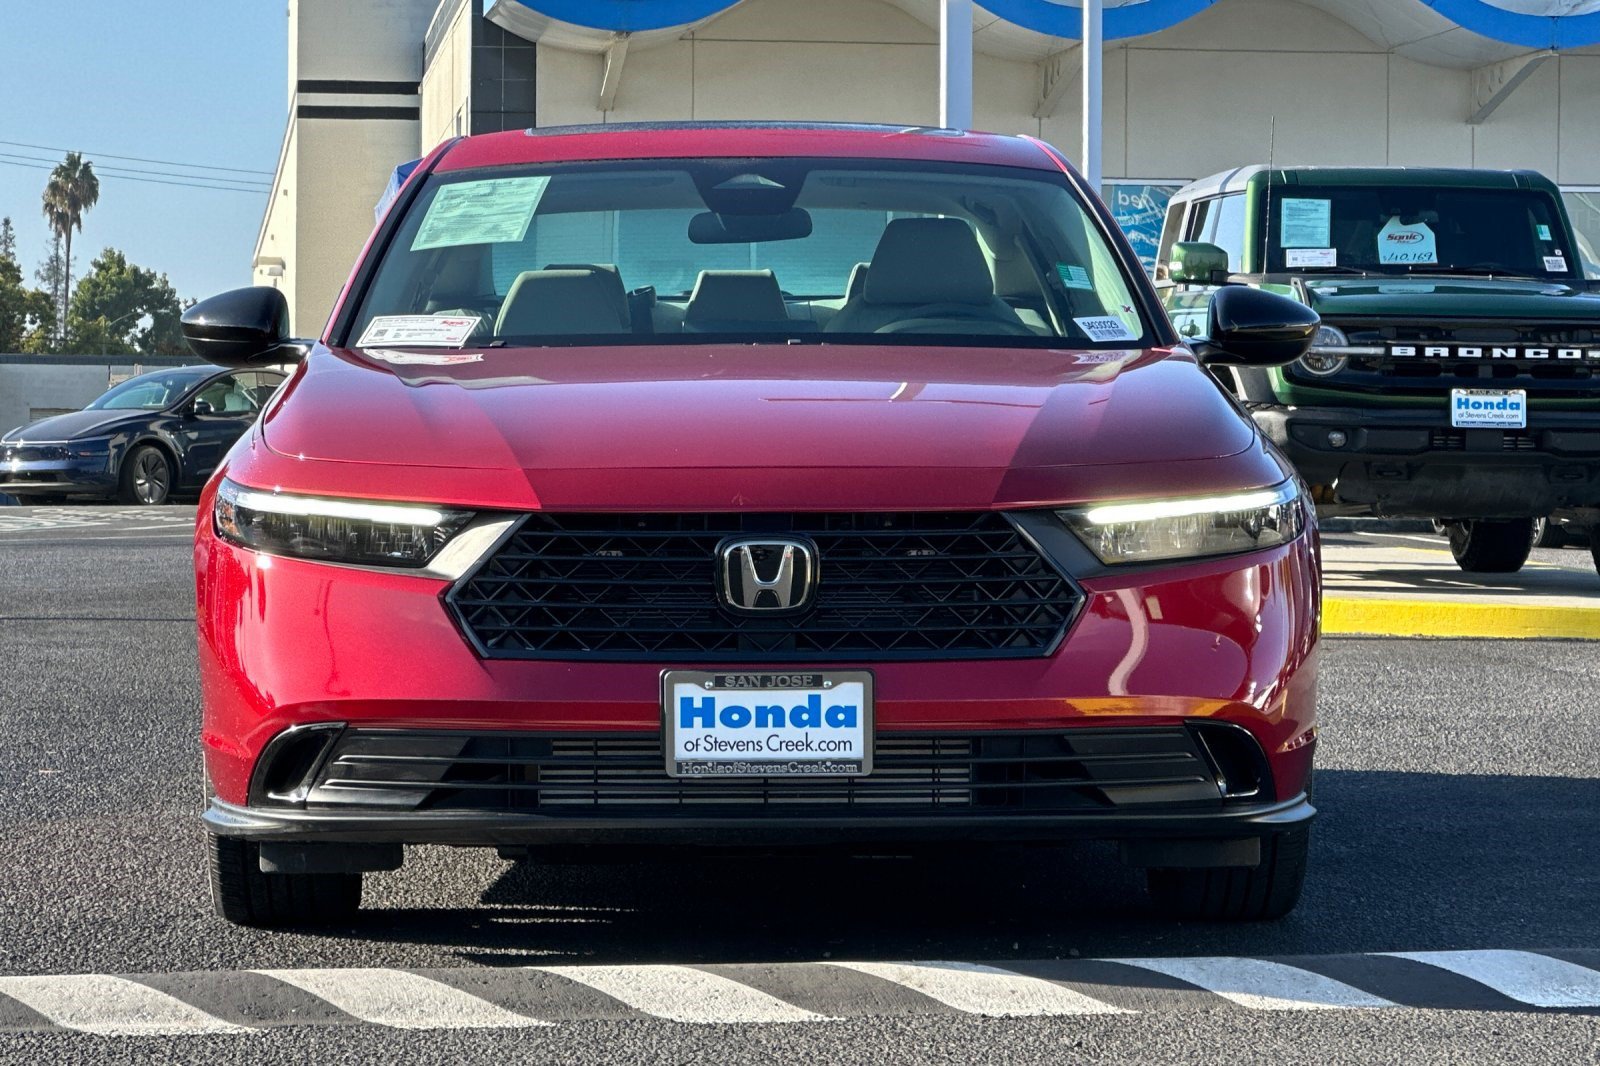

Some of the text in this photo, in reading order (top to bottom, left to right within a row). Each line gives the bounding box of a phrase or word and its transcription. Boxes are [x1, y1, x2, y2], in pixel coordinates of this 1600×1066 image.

[1387, 233, 1418, 241] Sonic
[1391, 346, 1582, 359] BRONCO
[1456, 397, 1521, 411] Honda
[1465, 411, 1487, 419] Stevens
[724, 675, 814, 688] SAN JOSE
[680, 694, 857, 729] Honda
[683, 732, 853, 752] of Stevens Creek.com
[681, 761, 858, 774] HondaofStevensCreek.com
